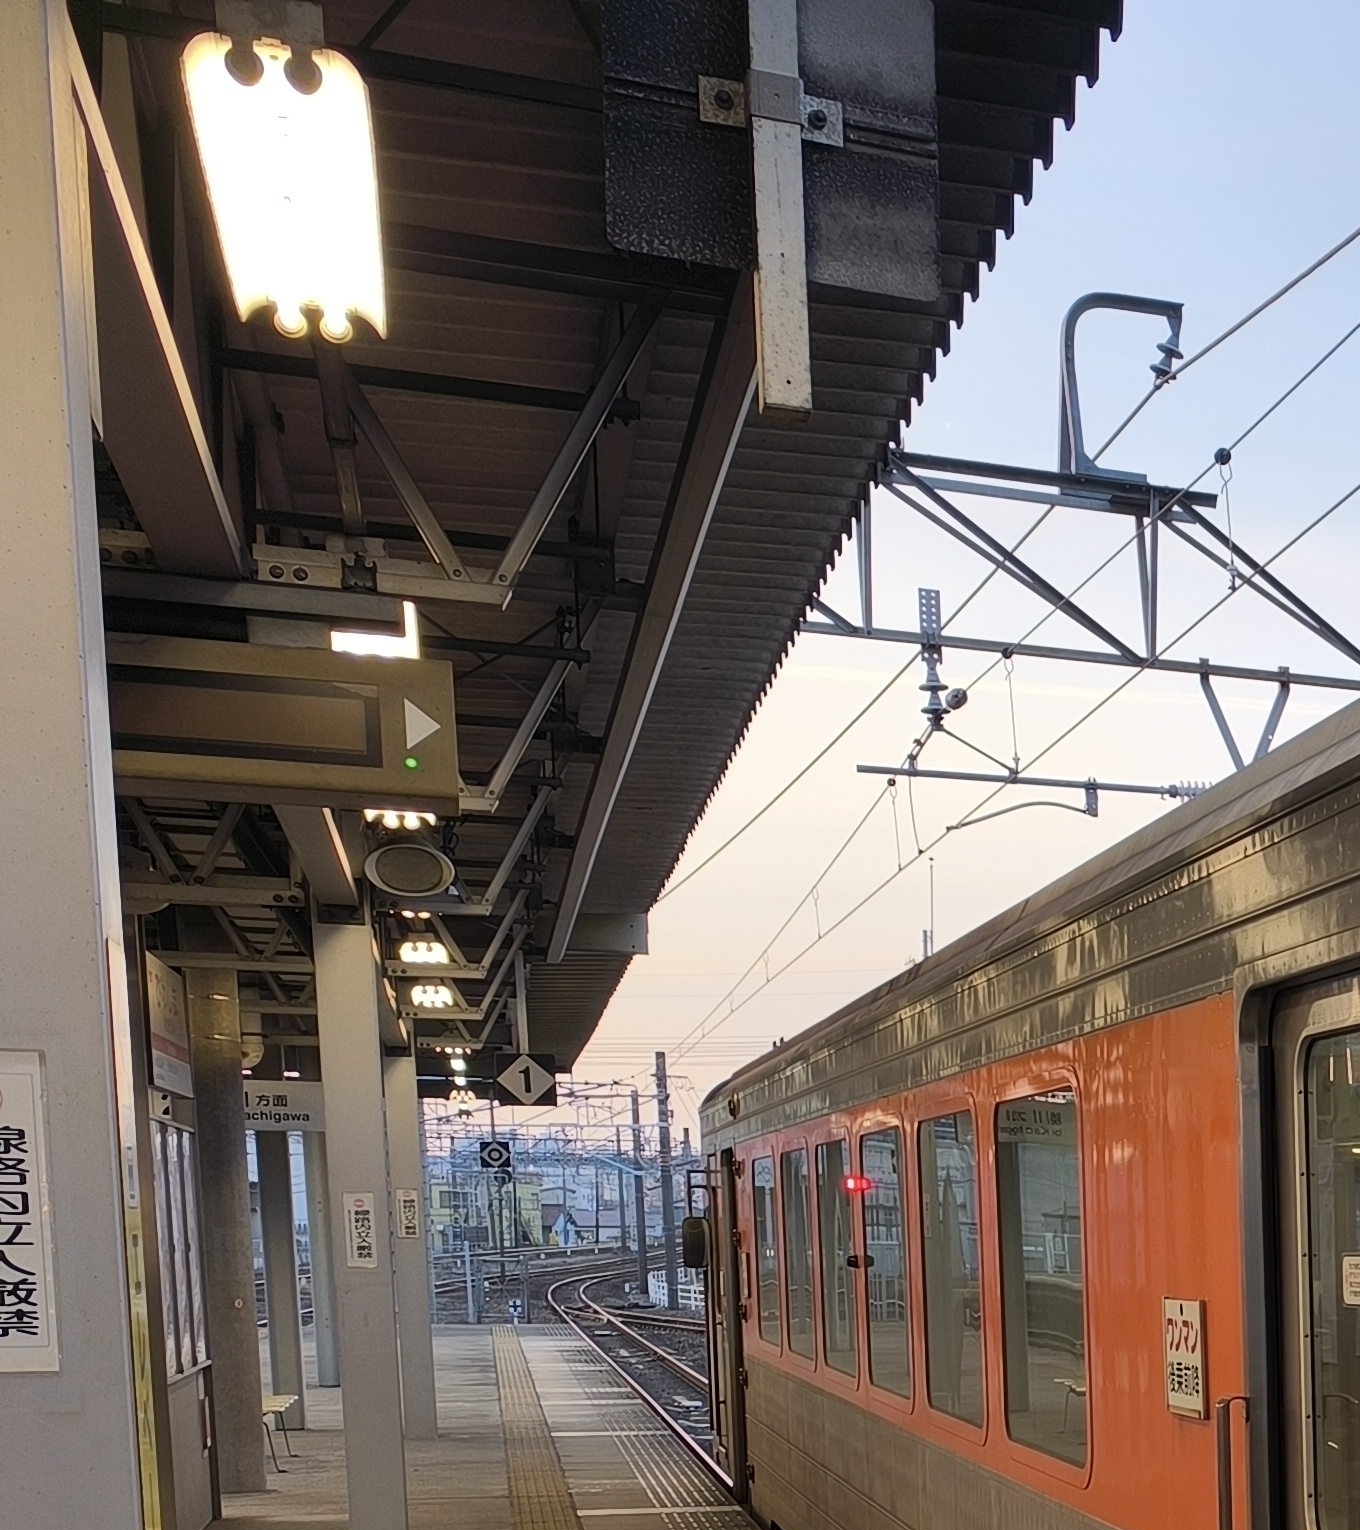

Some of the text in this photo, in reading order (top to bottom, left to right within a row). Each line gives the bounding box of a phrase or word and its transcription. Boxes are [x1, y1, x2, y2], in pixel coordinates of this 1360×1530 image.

[519, 1065, 532, 1094] 1
[244, 1091, 288, 1108] 方面
[1166, 1317, 1199, 1355] ワンマン
